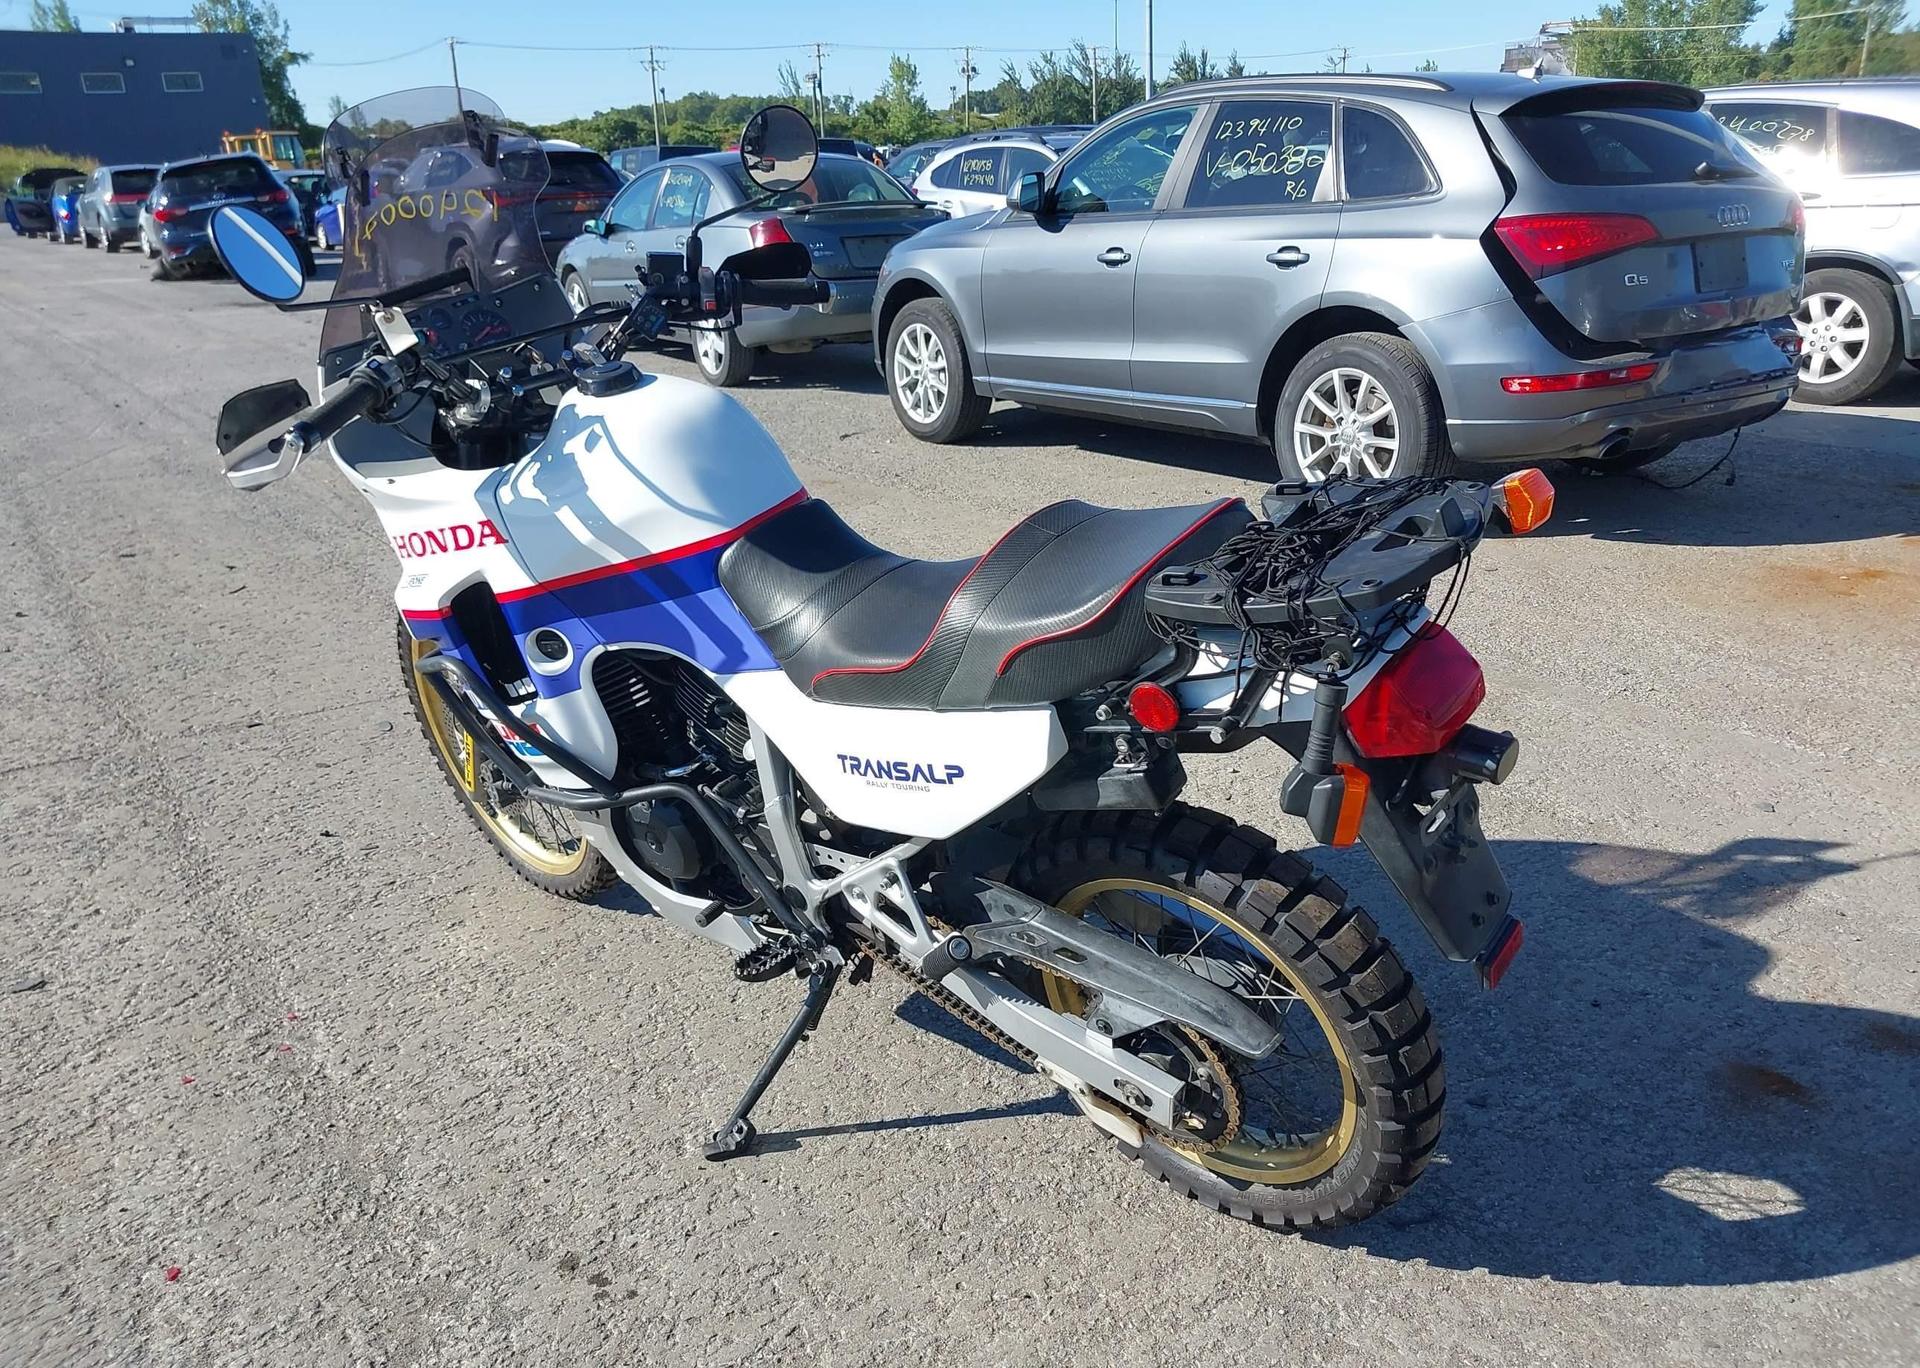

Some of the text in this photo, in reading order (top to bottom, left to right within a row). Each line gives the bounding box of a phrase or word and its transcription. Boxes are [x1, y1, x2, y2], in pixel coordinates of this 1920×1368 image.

[1215, 117, 1303, 140] 12394110
[1624, 273, 1649, 286] Q5
[393, 519, 509, 558] HONDA
[836, 753, 965, 785] TRANSALP
[866, 780, 931, 793] RALLY TOURING
